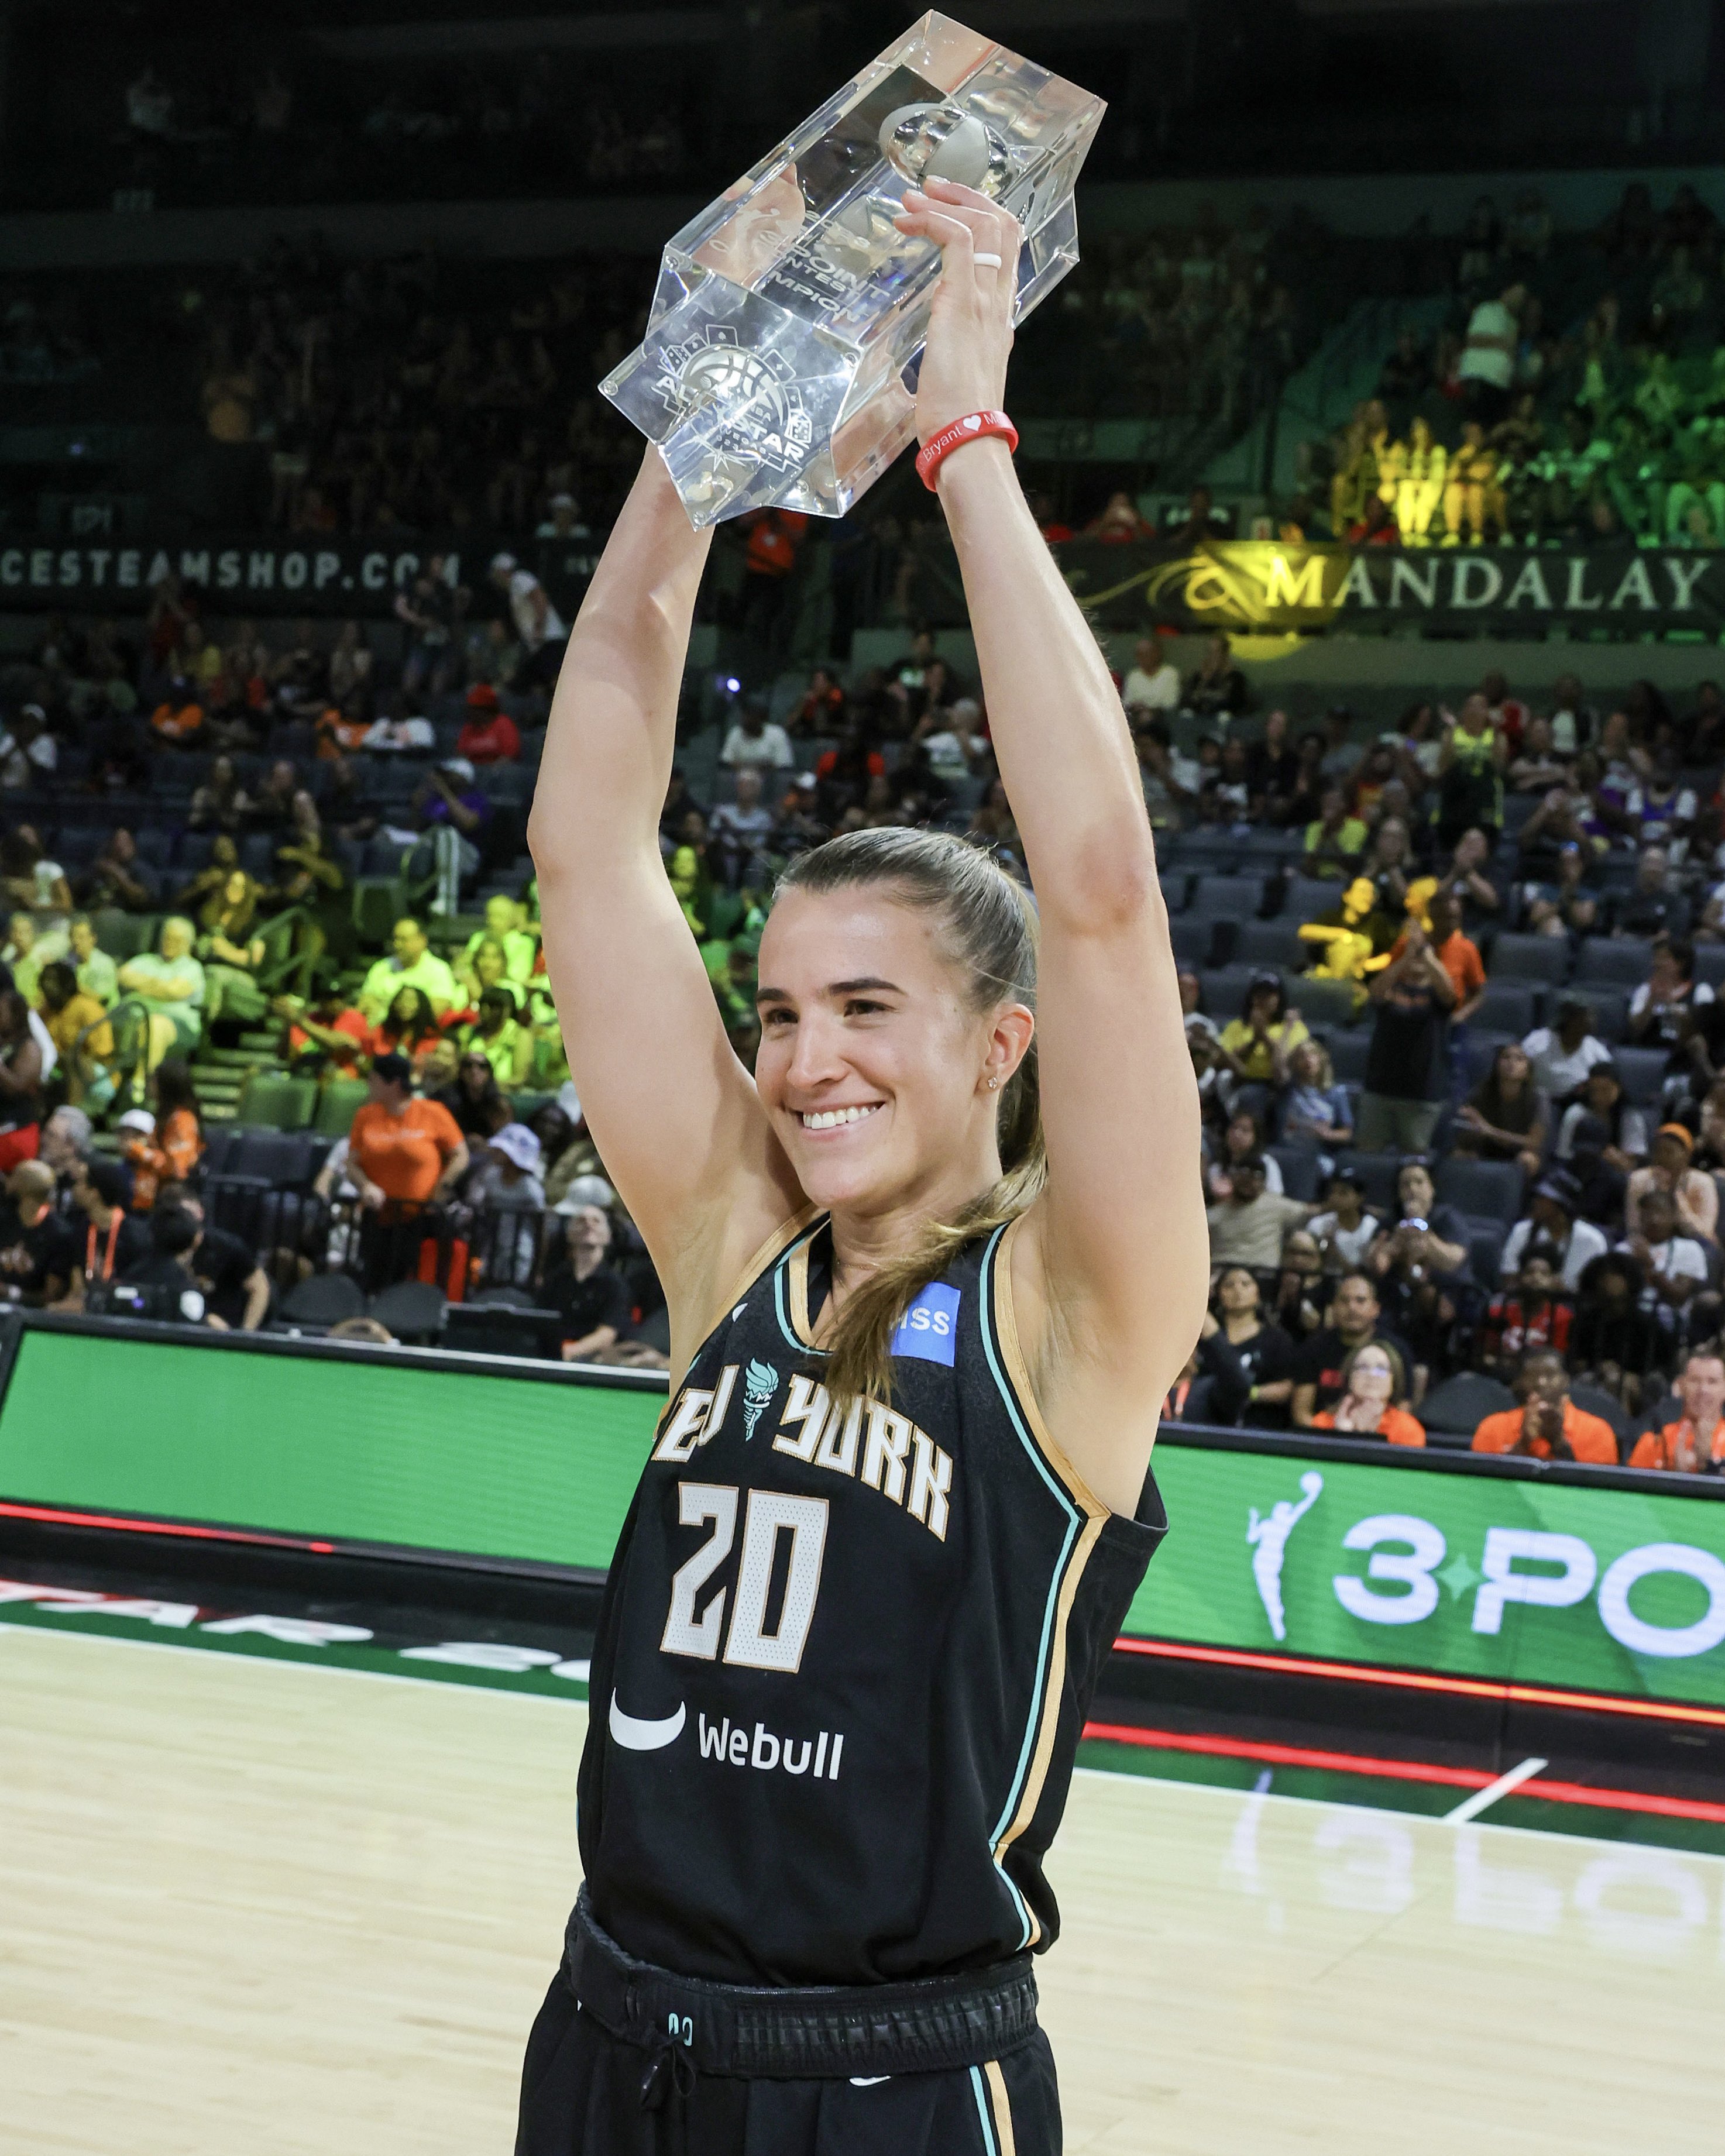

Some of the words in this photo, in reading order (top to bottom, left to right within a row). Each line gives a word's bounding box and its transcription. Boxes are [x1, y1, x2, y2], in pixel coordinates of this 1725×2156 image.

[922, 425, 963, 462] Bryant
[1264, 552, 1712, 611] MANDALAY
[771, 1373, 954, 1543] YORK
[659, 1481, 830, 1674] 20
[698, 1712, 844, 1781] Webull
